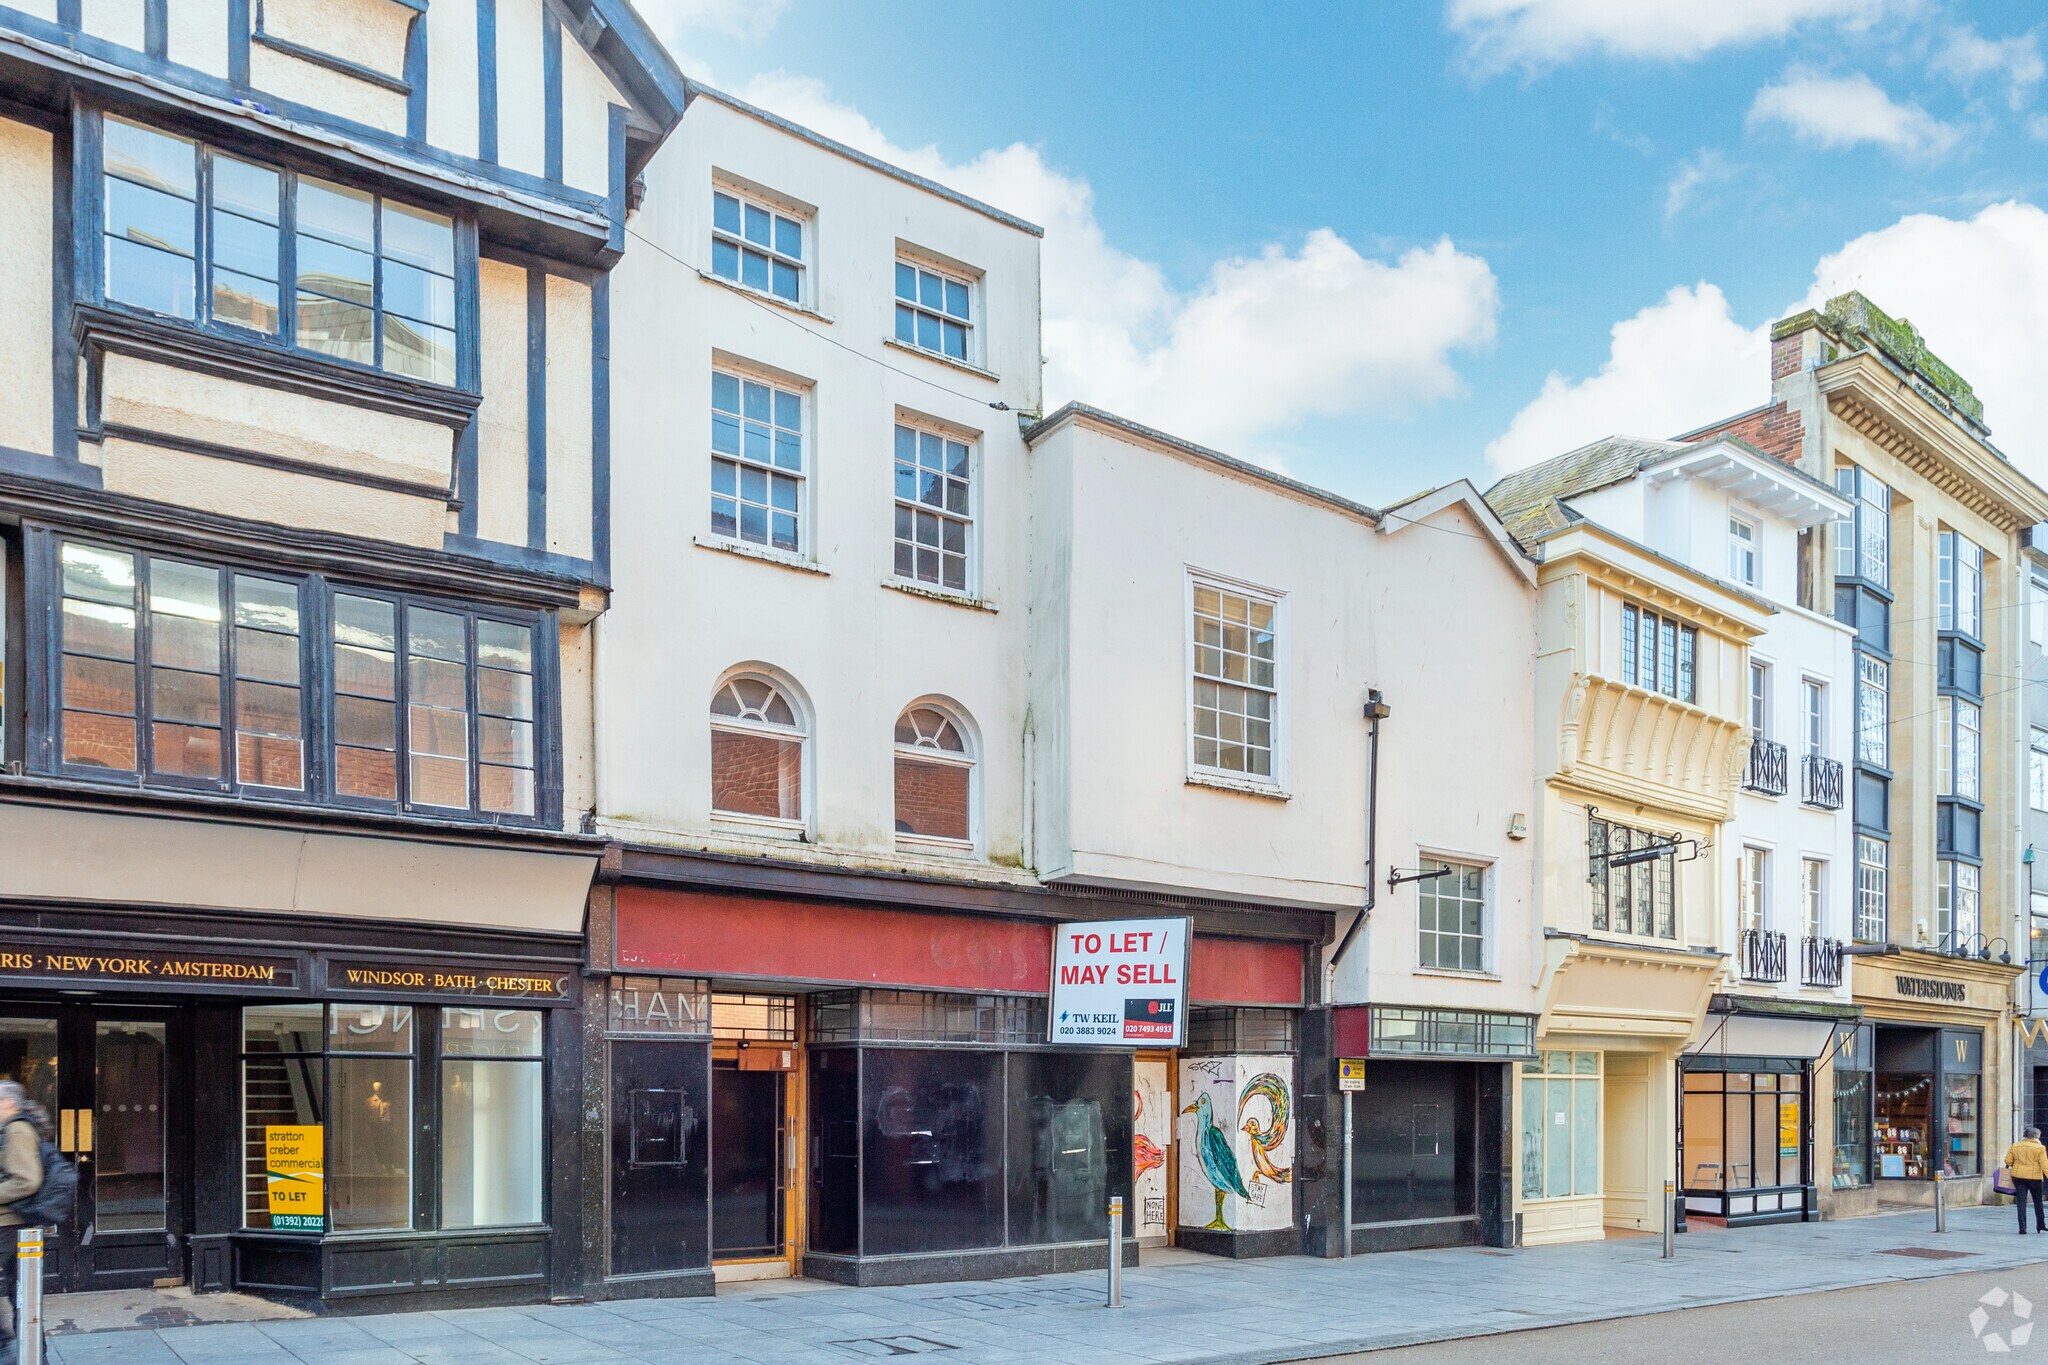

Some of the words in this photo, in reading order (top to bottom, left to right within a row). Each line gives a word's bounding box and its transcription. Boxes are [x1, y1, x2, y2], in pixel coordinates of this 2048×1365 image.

[1070, 934, 1102, 954] TO
[1109, 932, 1153, 953] LET
[46, 955, 94, 971] NEW
[96, 958, 152, 974] YORK
[160, 960, 275, 980] AMSTERDAM
[347, 969, 426, 986] WINDSOR
[434, 974, 477, 989] BATH
[486, 976, 553, 992] CHESTER
[1060, 965, 1110, 985] MAY
[1116, 964, 1177, 985] SELL
[1895, 975, 1966, 1001] WATERSTONES
[1073, 1013, 1091, 1023] TW
[1093, 1013, 1119, 1023] KEIL
[1060, 1027, 1074, 1035] 020
[1076, 1027, 1095, 1035] 3883
[1097, 1027, 1116, 1035] 9024
[1839, 1032, 1854, 1058] W
[1956, 1040, 1968, 1063] W
[269, 1132, 304, 1141] stratton
[269, 1144, 299, 1155] creber
[269, 1157, 324, 1169] commercial
[272, 1191, 285, 1201] TO
[289, 1192, 307, 1202] LET
[273, 1215, 301, 1227] (01392)
[1146, 1210, 1163, 1222] HERE
